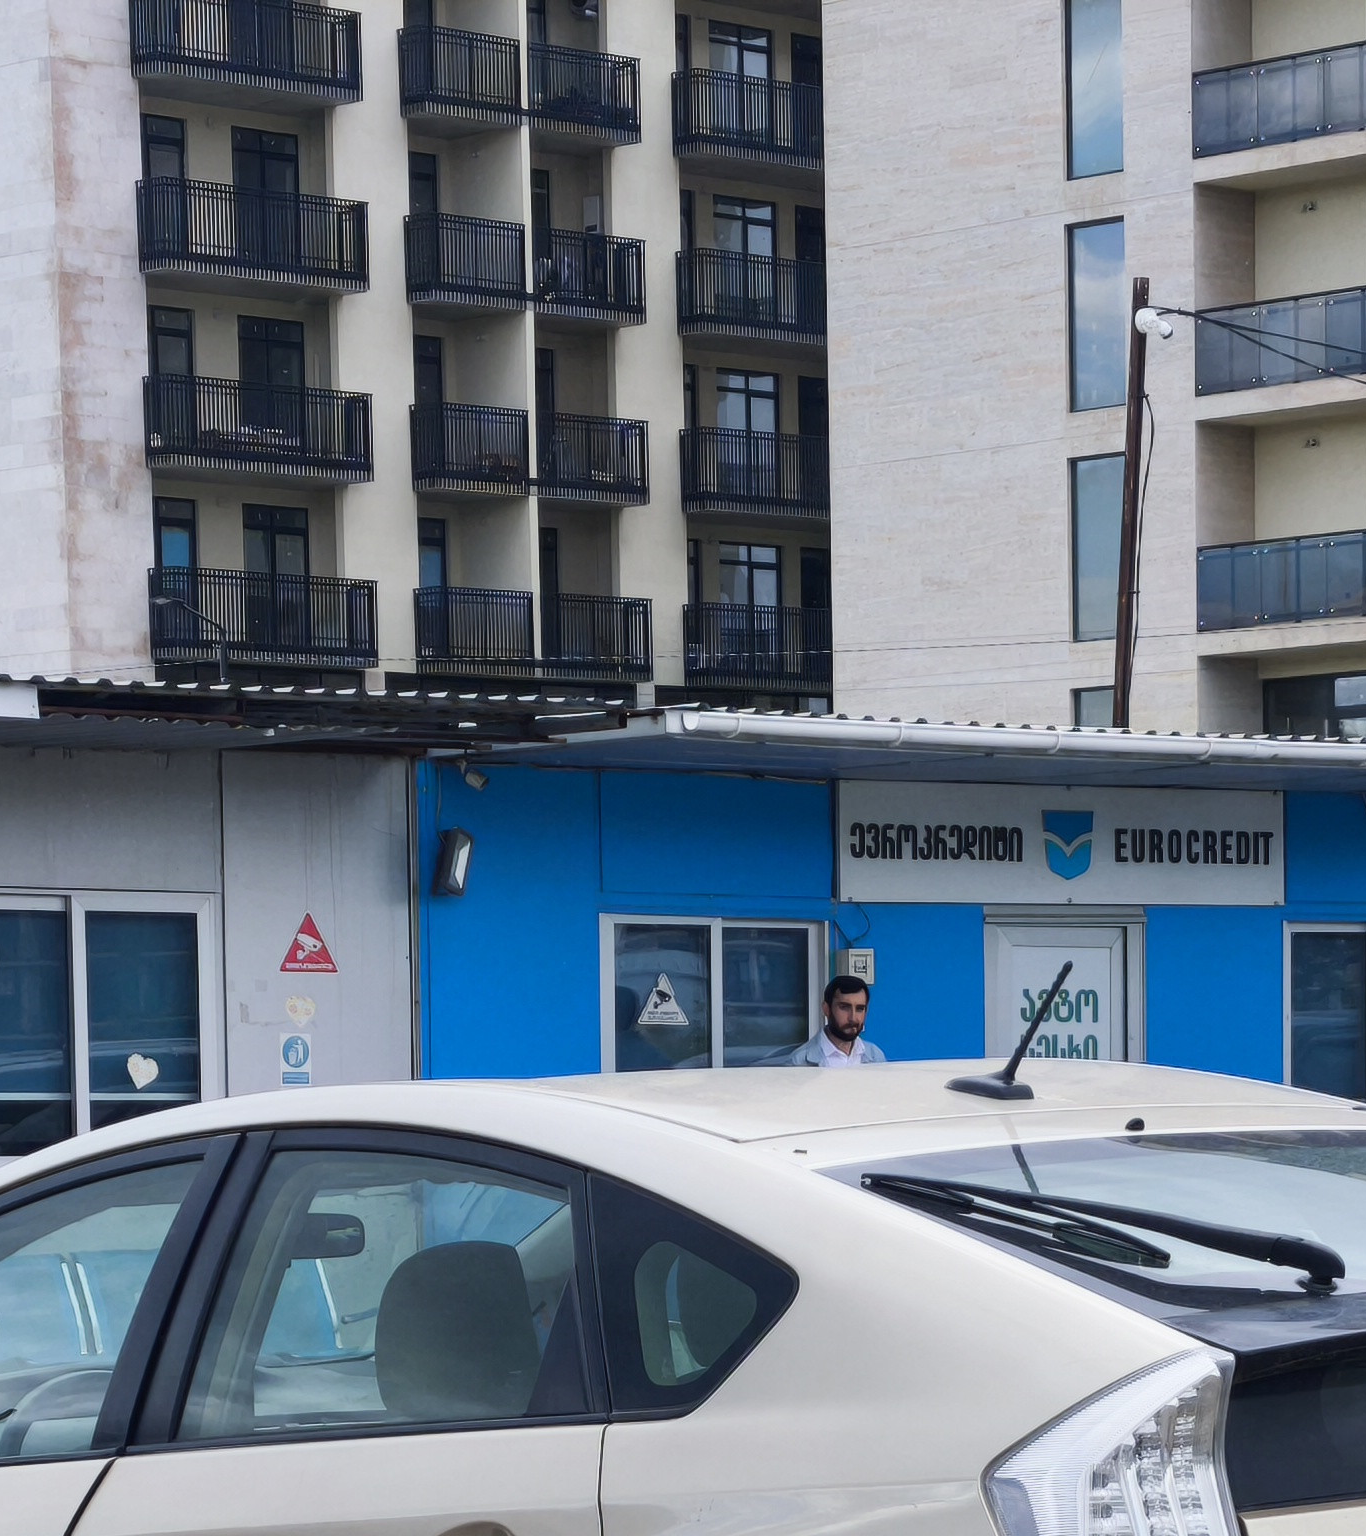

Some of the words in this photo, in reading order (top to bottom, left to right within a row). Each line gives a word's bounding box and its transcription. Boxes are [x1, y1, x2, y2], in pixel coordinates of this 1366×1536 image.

[849, 821, 1024, 863] ევროკრედიტი
[1114, 828, 1275, 866] EUROCREDIT
[1020, 988, 1099, 1023] ავტო
